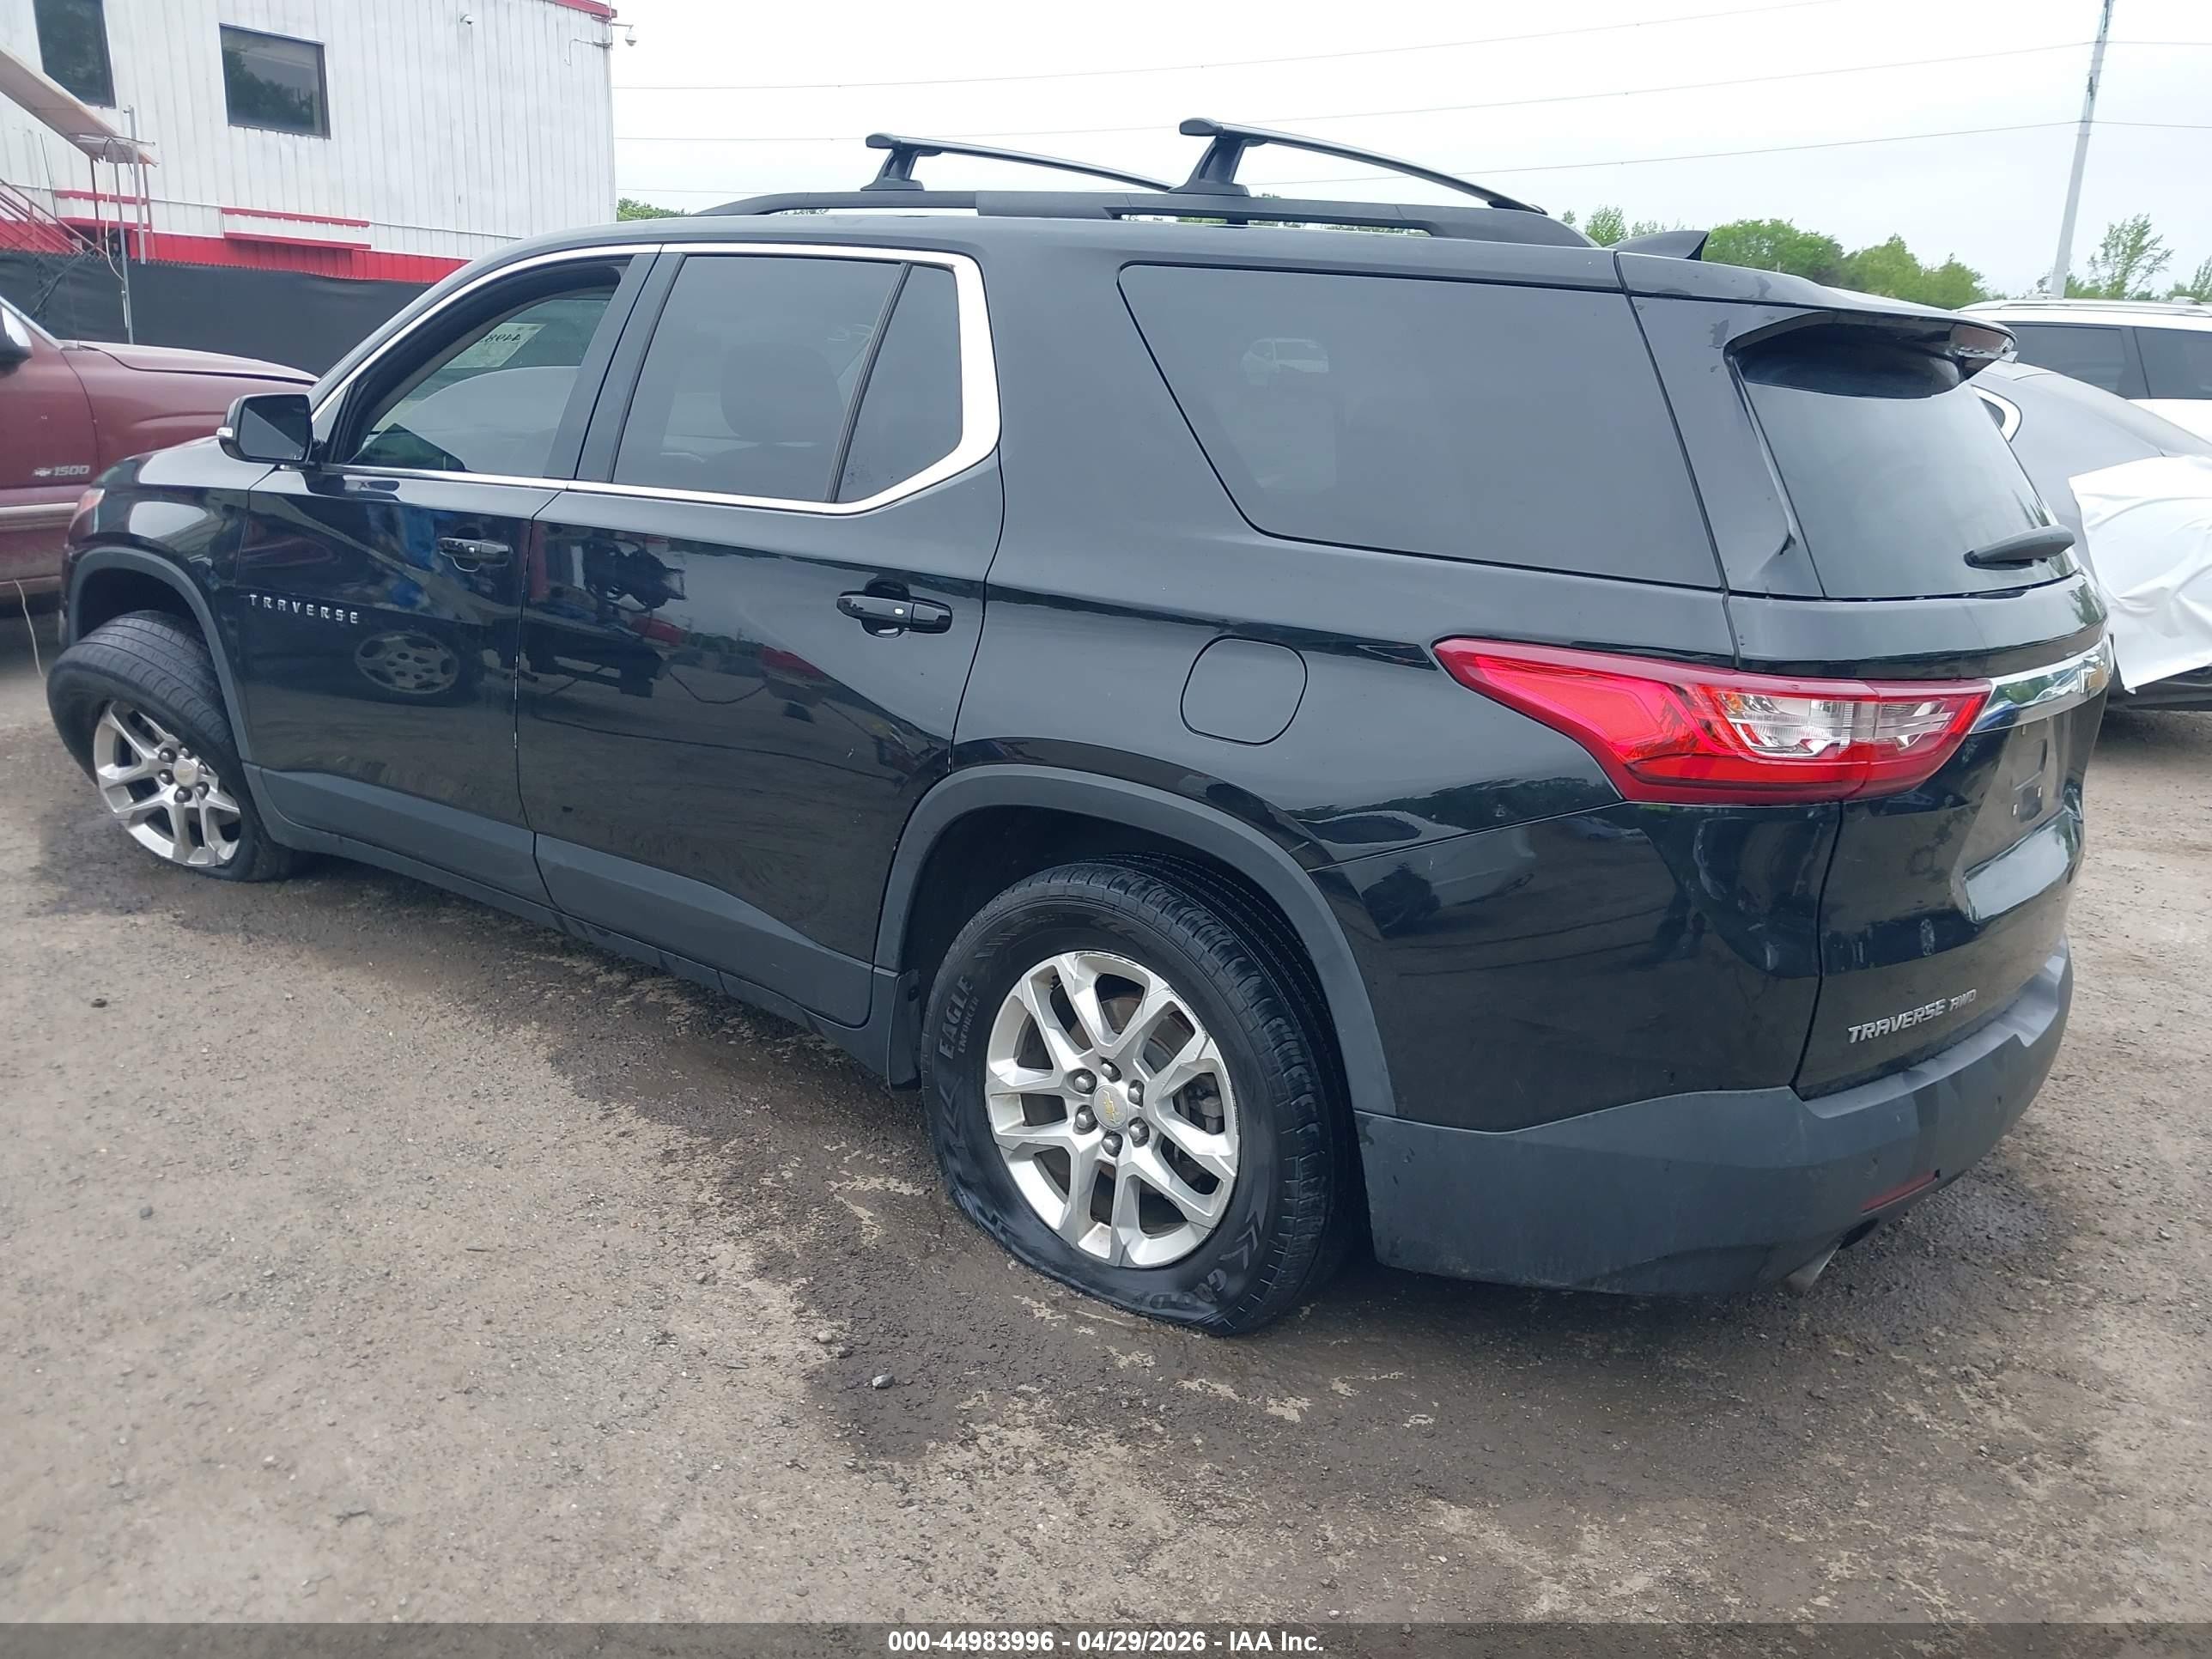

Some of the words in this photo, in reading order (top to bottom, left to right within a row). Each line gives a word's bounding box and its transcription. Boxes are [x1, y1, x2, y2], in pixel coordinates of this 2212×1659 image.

[54, 465, 90, 477] 1500
[249, 593, 359, 624] TRAVERSE
[939, 975, 974, 1060] EAGLE
[1847, 998, 1947, 1044] TRAVERSE
[1948, 988, 1977, 1012] AWD
